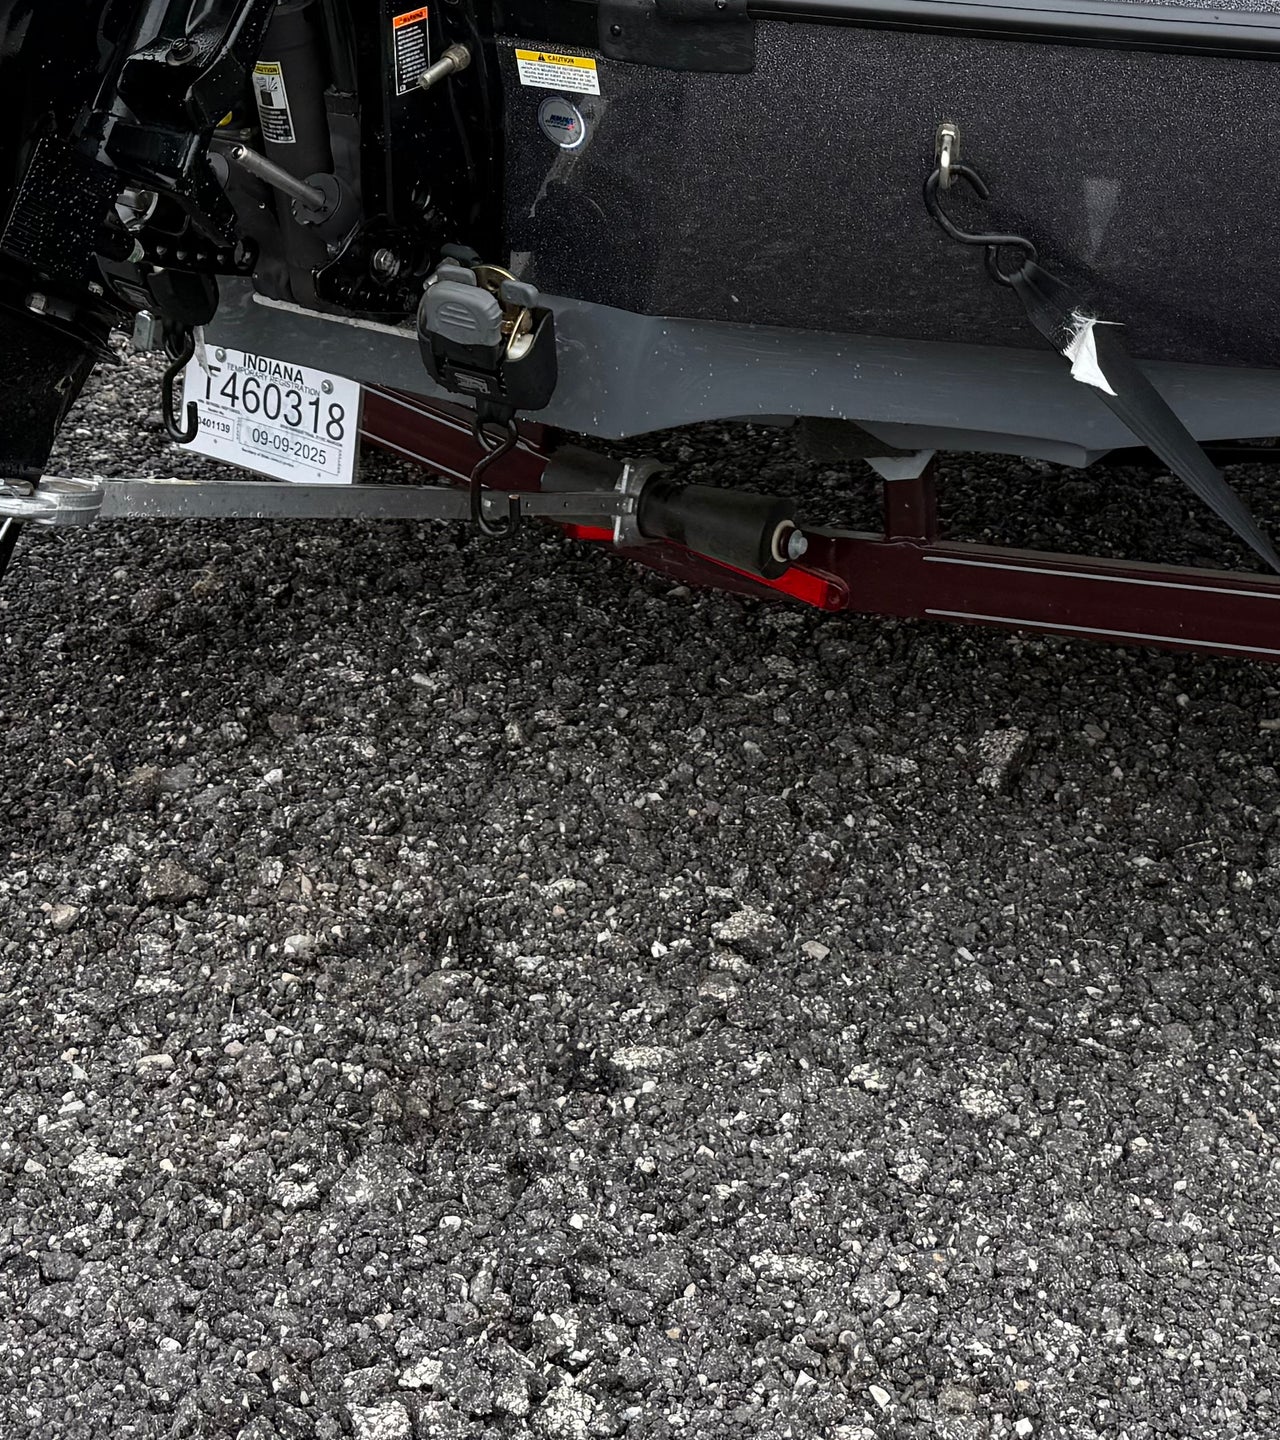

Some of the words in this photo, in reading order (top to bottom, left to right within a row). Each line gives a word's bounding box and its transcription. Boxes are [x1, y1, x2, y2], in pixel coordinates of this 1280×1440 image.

[547, 55, 575, 65] CAUTION
[226, 361, 270, 382] TEMPORARY
[269, 375, 321, 398] REGISTRATION
[243, 352, 305, 386] INDIANA
[251, 427, 327, 466] 09-09-2025
